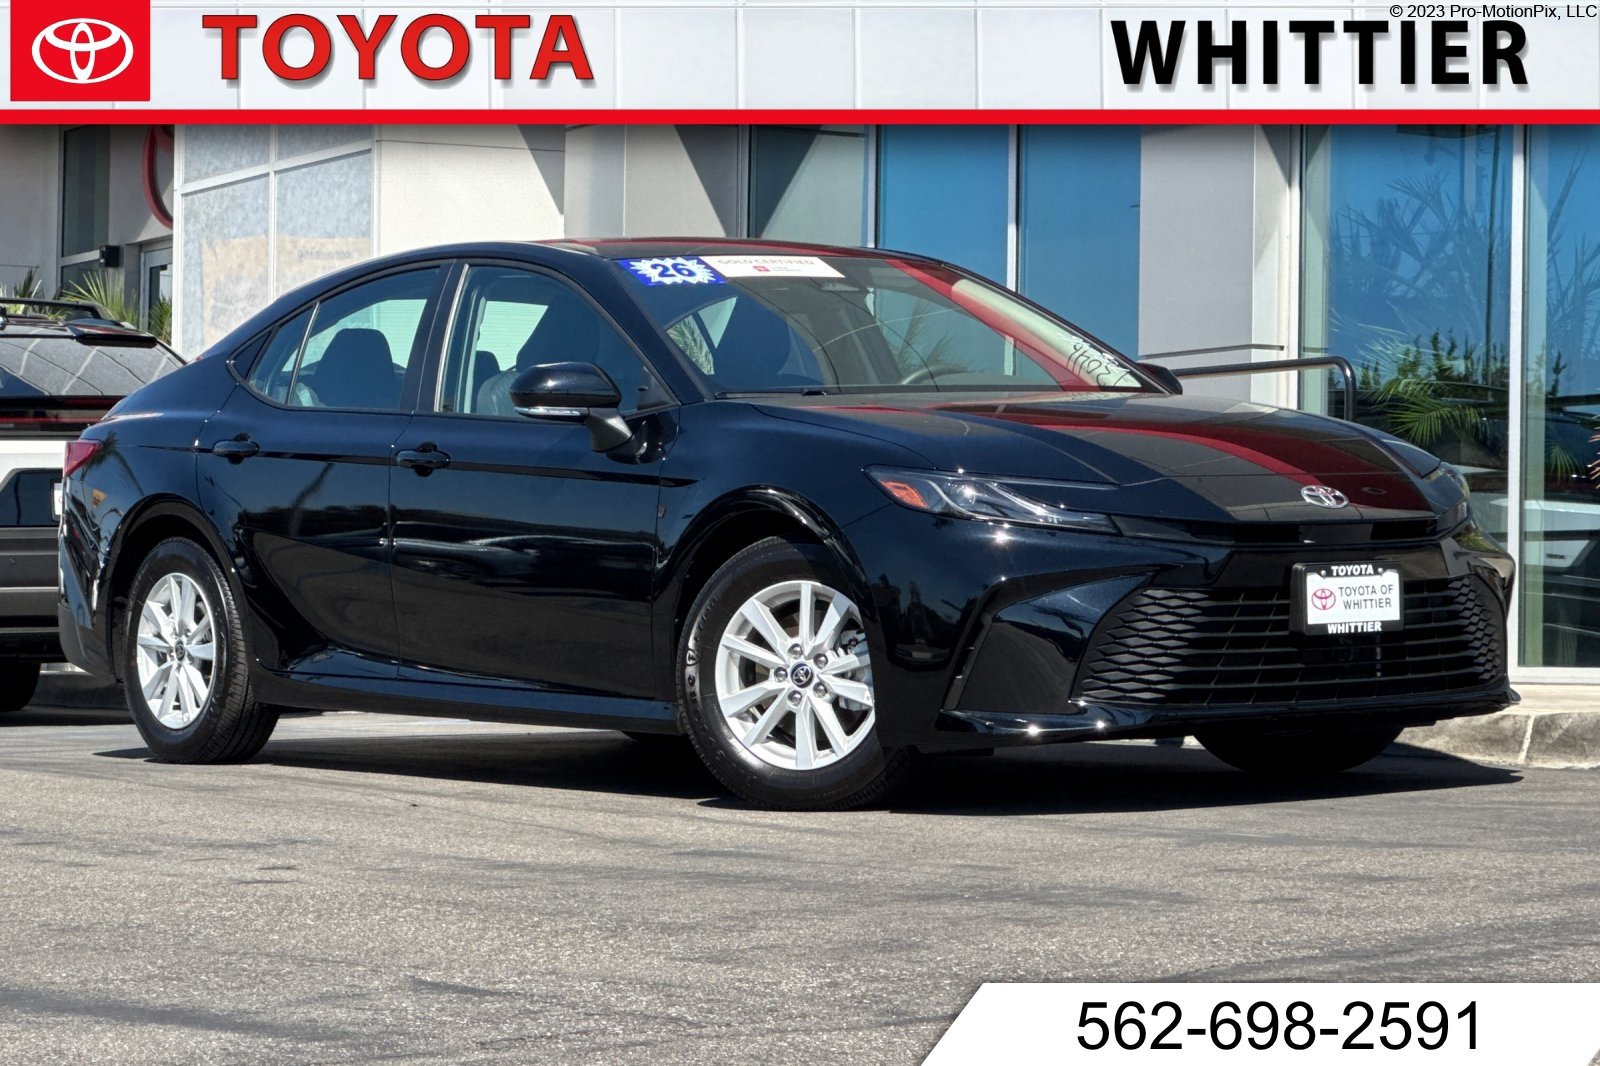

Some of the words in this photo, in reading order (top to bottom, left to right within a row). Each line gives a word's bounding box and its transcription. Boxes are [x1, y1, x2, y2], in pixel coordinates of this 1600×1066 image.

[650, 262, 697, 278] 26
[1331, 564, 1375, 577] TOYOTA
[1338, 585, 1377, 597] TOYOTA
[1380, 584, 1394, 595] OF
[1343, 597, 1392, 611] WHITTIER
[1327, 621, 1383, 634] WHITTIER
